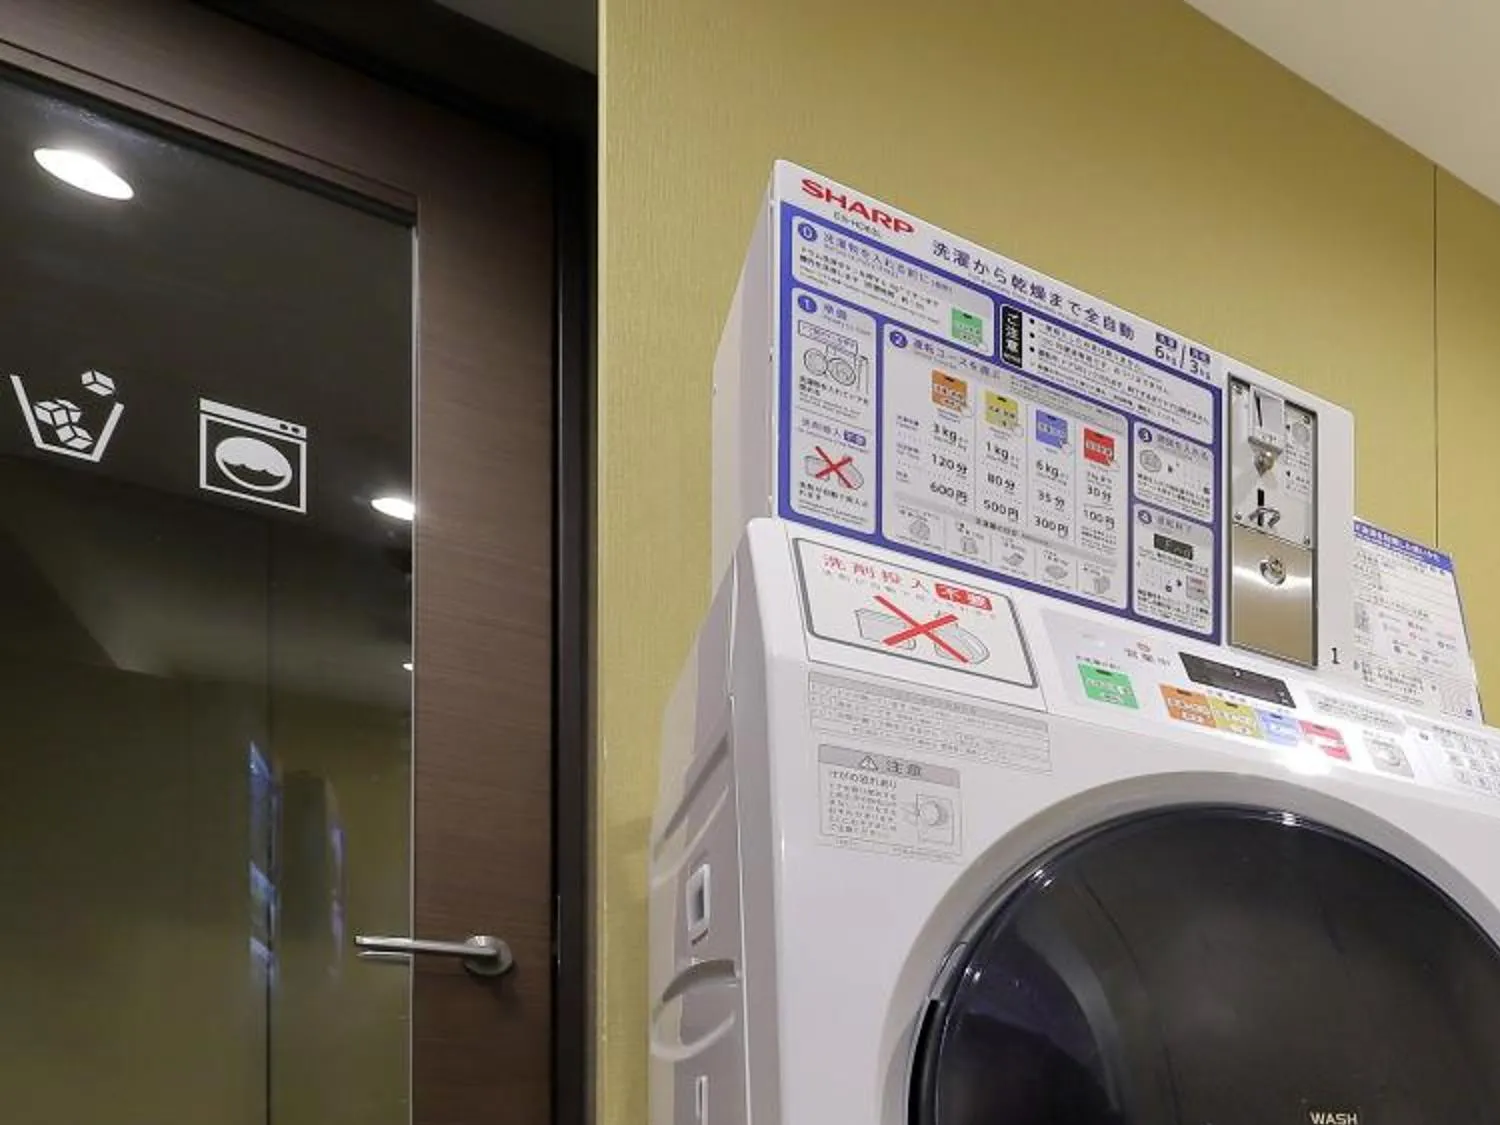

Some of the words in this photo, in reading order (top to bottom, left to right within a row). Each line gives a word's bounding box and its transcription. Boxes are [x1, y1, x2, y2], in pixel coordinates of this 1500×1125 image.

[801, 178, 914, 234] SHARP
[932, 240, 1135, 341] 洗濯から乾燥まで全自動
[931, 453, 968, 475] 120分
[929, 483, 968, 505] 600円
[1309, 1111, 1358, 1125] WASH
